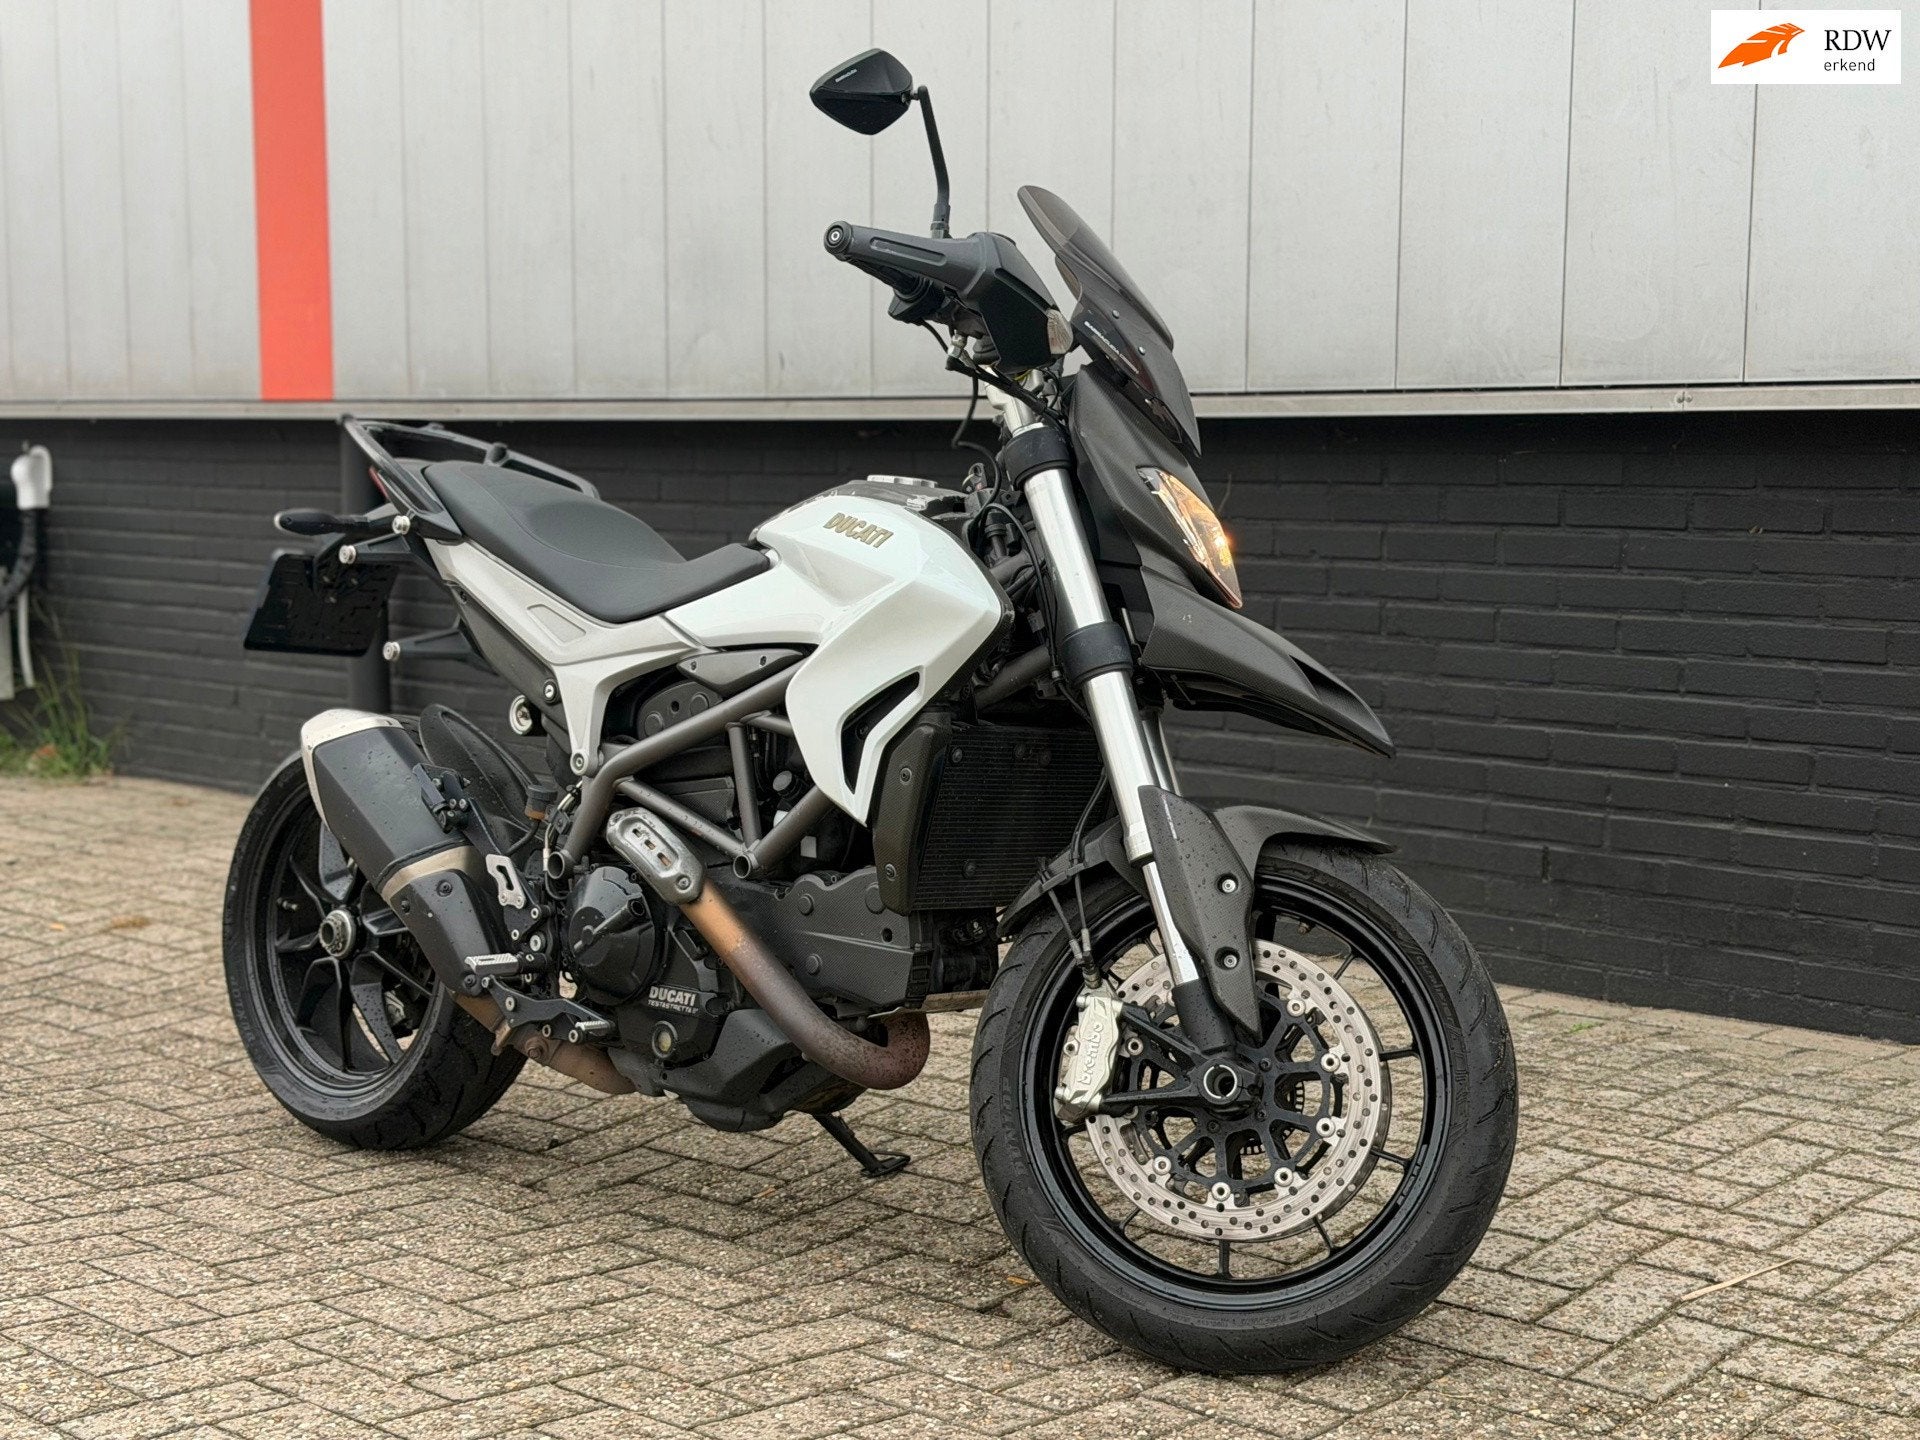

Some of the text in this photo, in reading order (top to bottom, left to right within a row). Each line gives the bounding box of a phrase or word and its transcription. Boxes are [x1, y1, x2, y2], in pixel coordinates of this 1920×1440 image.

[823, 512, 894, 548] DUCATI
[648, 985, 697, 1007] DUCATI
[1077, 1022, 1104, 1086] brembo
